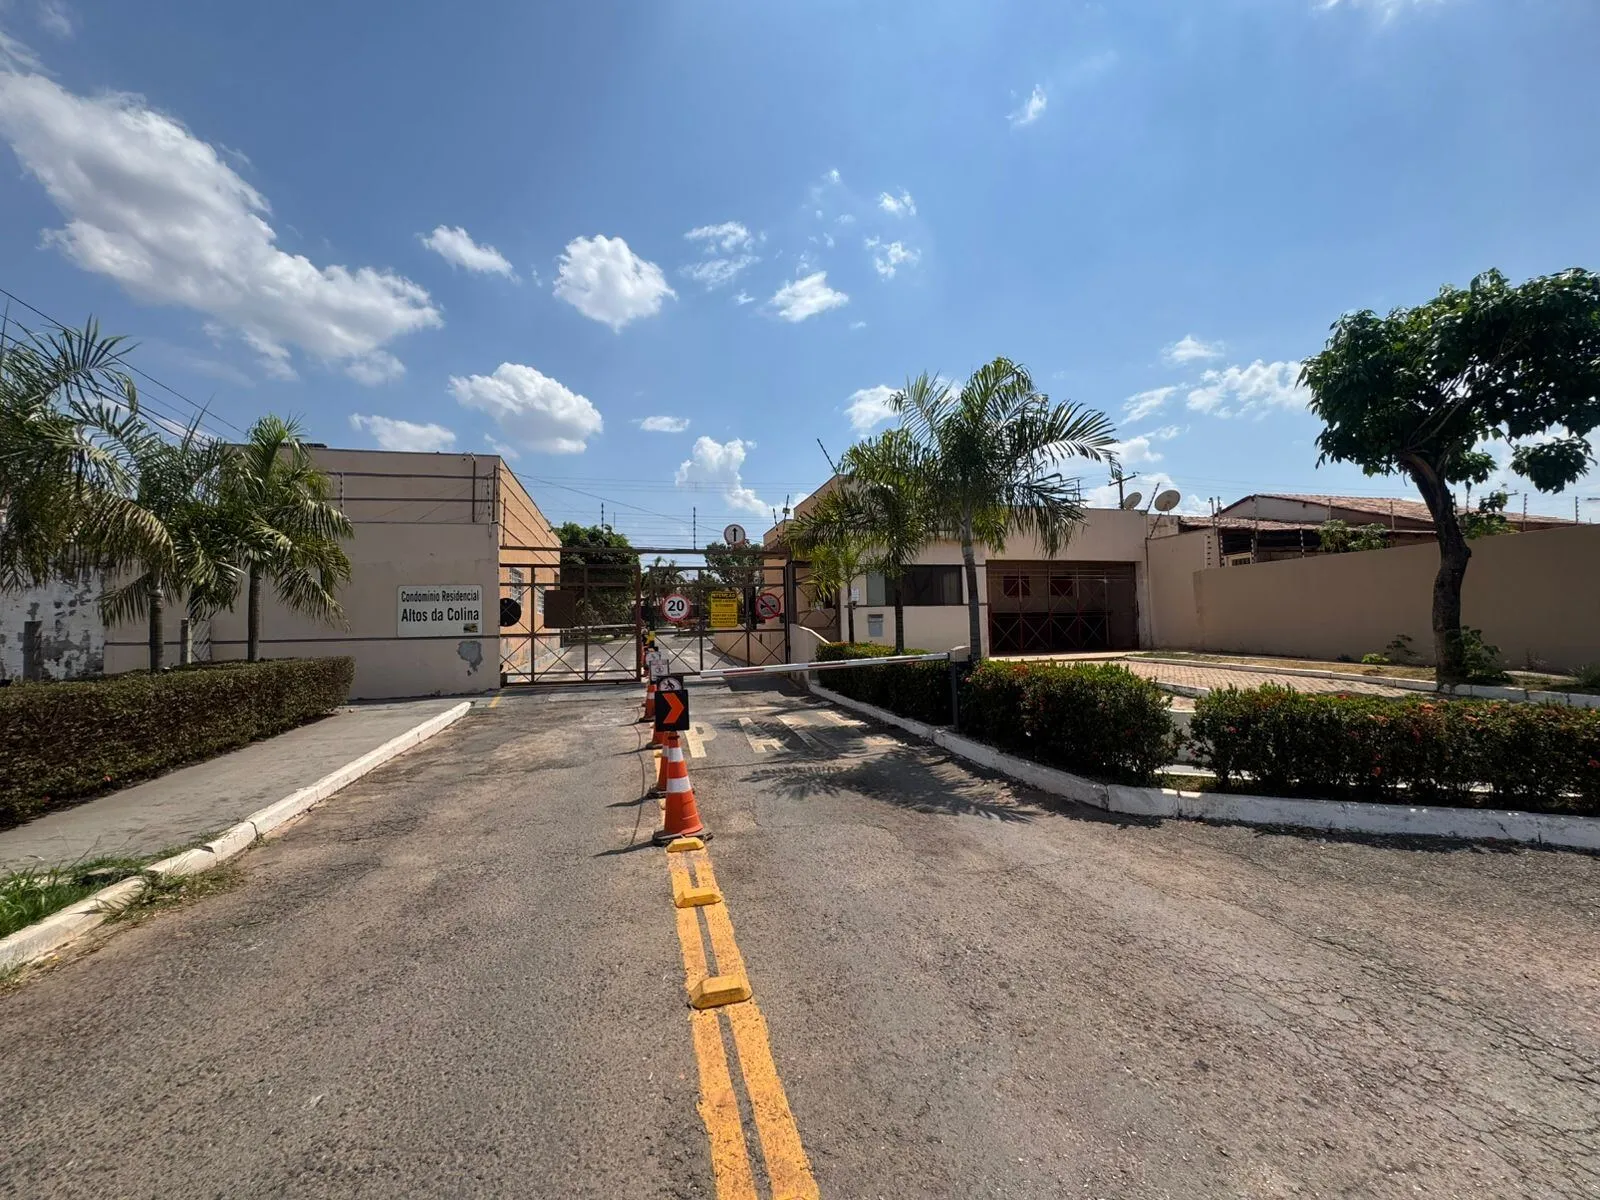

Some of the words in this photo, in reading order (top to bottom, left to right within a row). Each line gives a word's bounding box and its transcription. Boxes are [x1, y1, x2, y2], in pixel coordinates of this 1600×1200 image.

[442, 590, 479, 601] Residencial
[668, 600, 684, 611] 20
[401, 608, 428, 622] Altos
[431, 608, 444, 621] da
[447, 607, 479, 621] Colina
